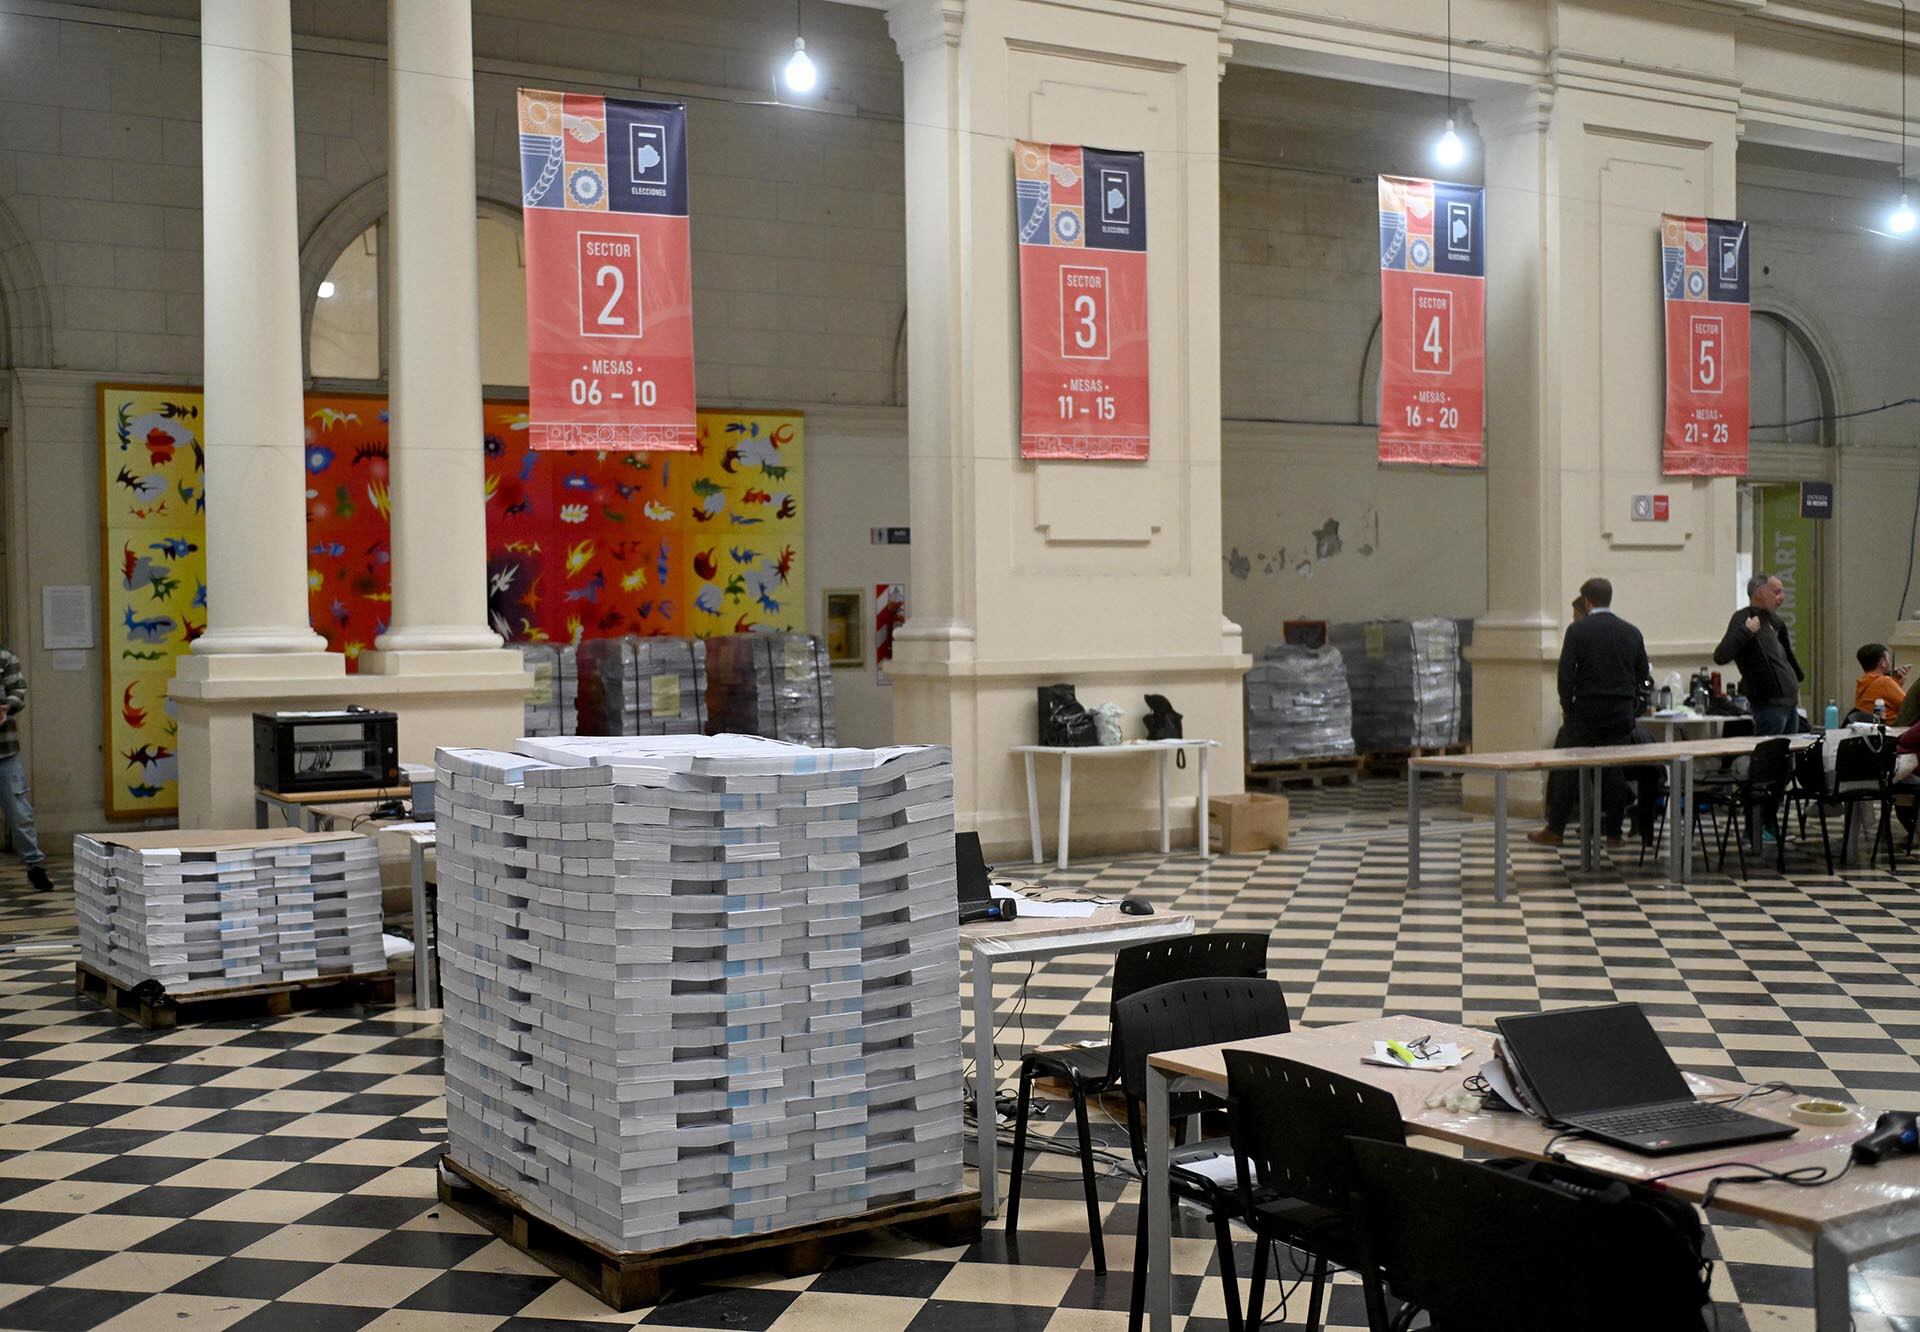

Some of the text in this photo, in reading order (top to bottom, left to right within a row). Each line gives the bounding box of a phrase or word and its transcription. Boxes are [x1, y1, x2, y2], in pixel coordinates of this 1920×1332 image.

[631, 187, 667, 197] ELECCIONES
[587, 242, 631, 258] SECTOR
[1067, 275, 1101, 289] SECTOR
[596, 265, 625, 326] 2
[1418, 297, 1447, 310] SECTOR
[1074, 295, 1097, 349] 3
[1695, 323, 1719, 335] SECTOR
[1423, 315, 1443, 365] 4
[592, 359, 633, 375] MESAS
[1700, 340, 1715, 384] 5
[571, 379, 602, 405] 06
[631, 380, 657, 407] 10
[1070, 379, 1103, 392] MESAS
[1419, 390, 1446, 403] MESAS
[1058, 395, 1073, 419] 11
[1096, 396, 1116, 420] 15
[1405, 405, 1422, 428] 16
[1439, 407, 1458, 429] 20
[1684, 422, 1698, 443] 21
[1712, 423, 1729, 443] 25
